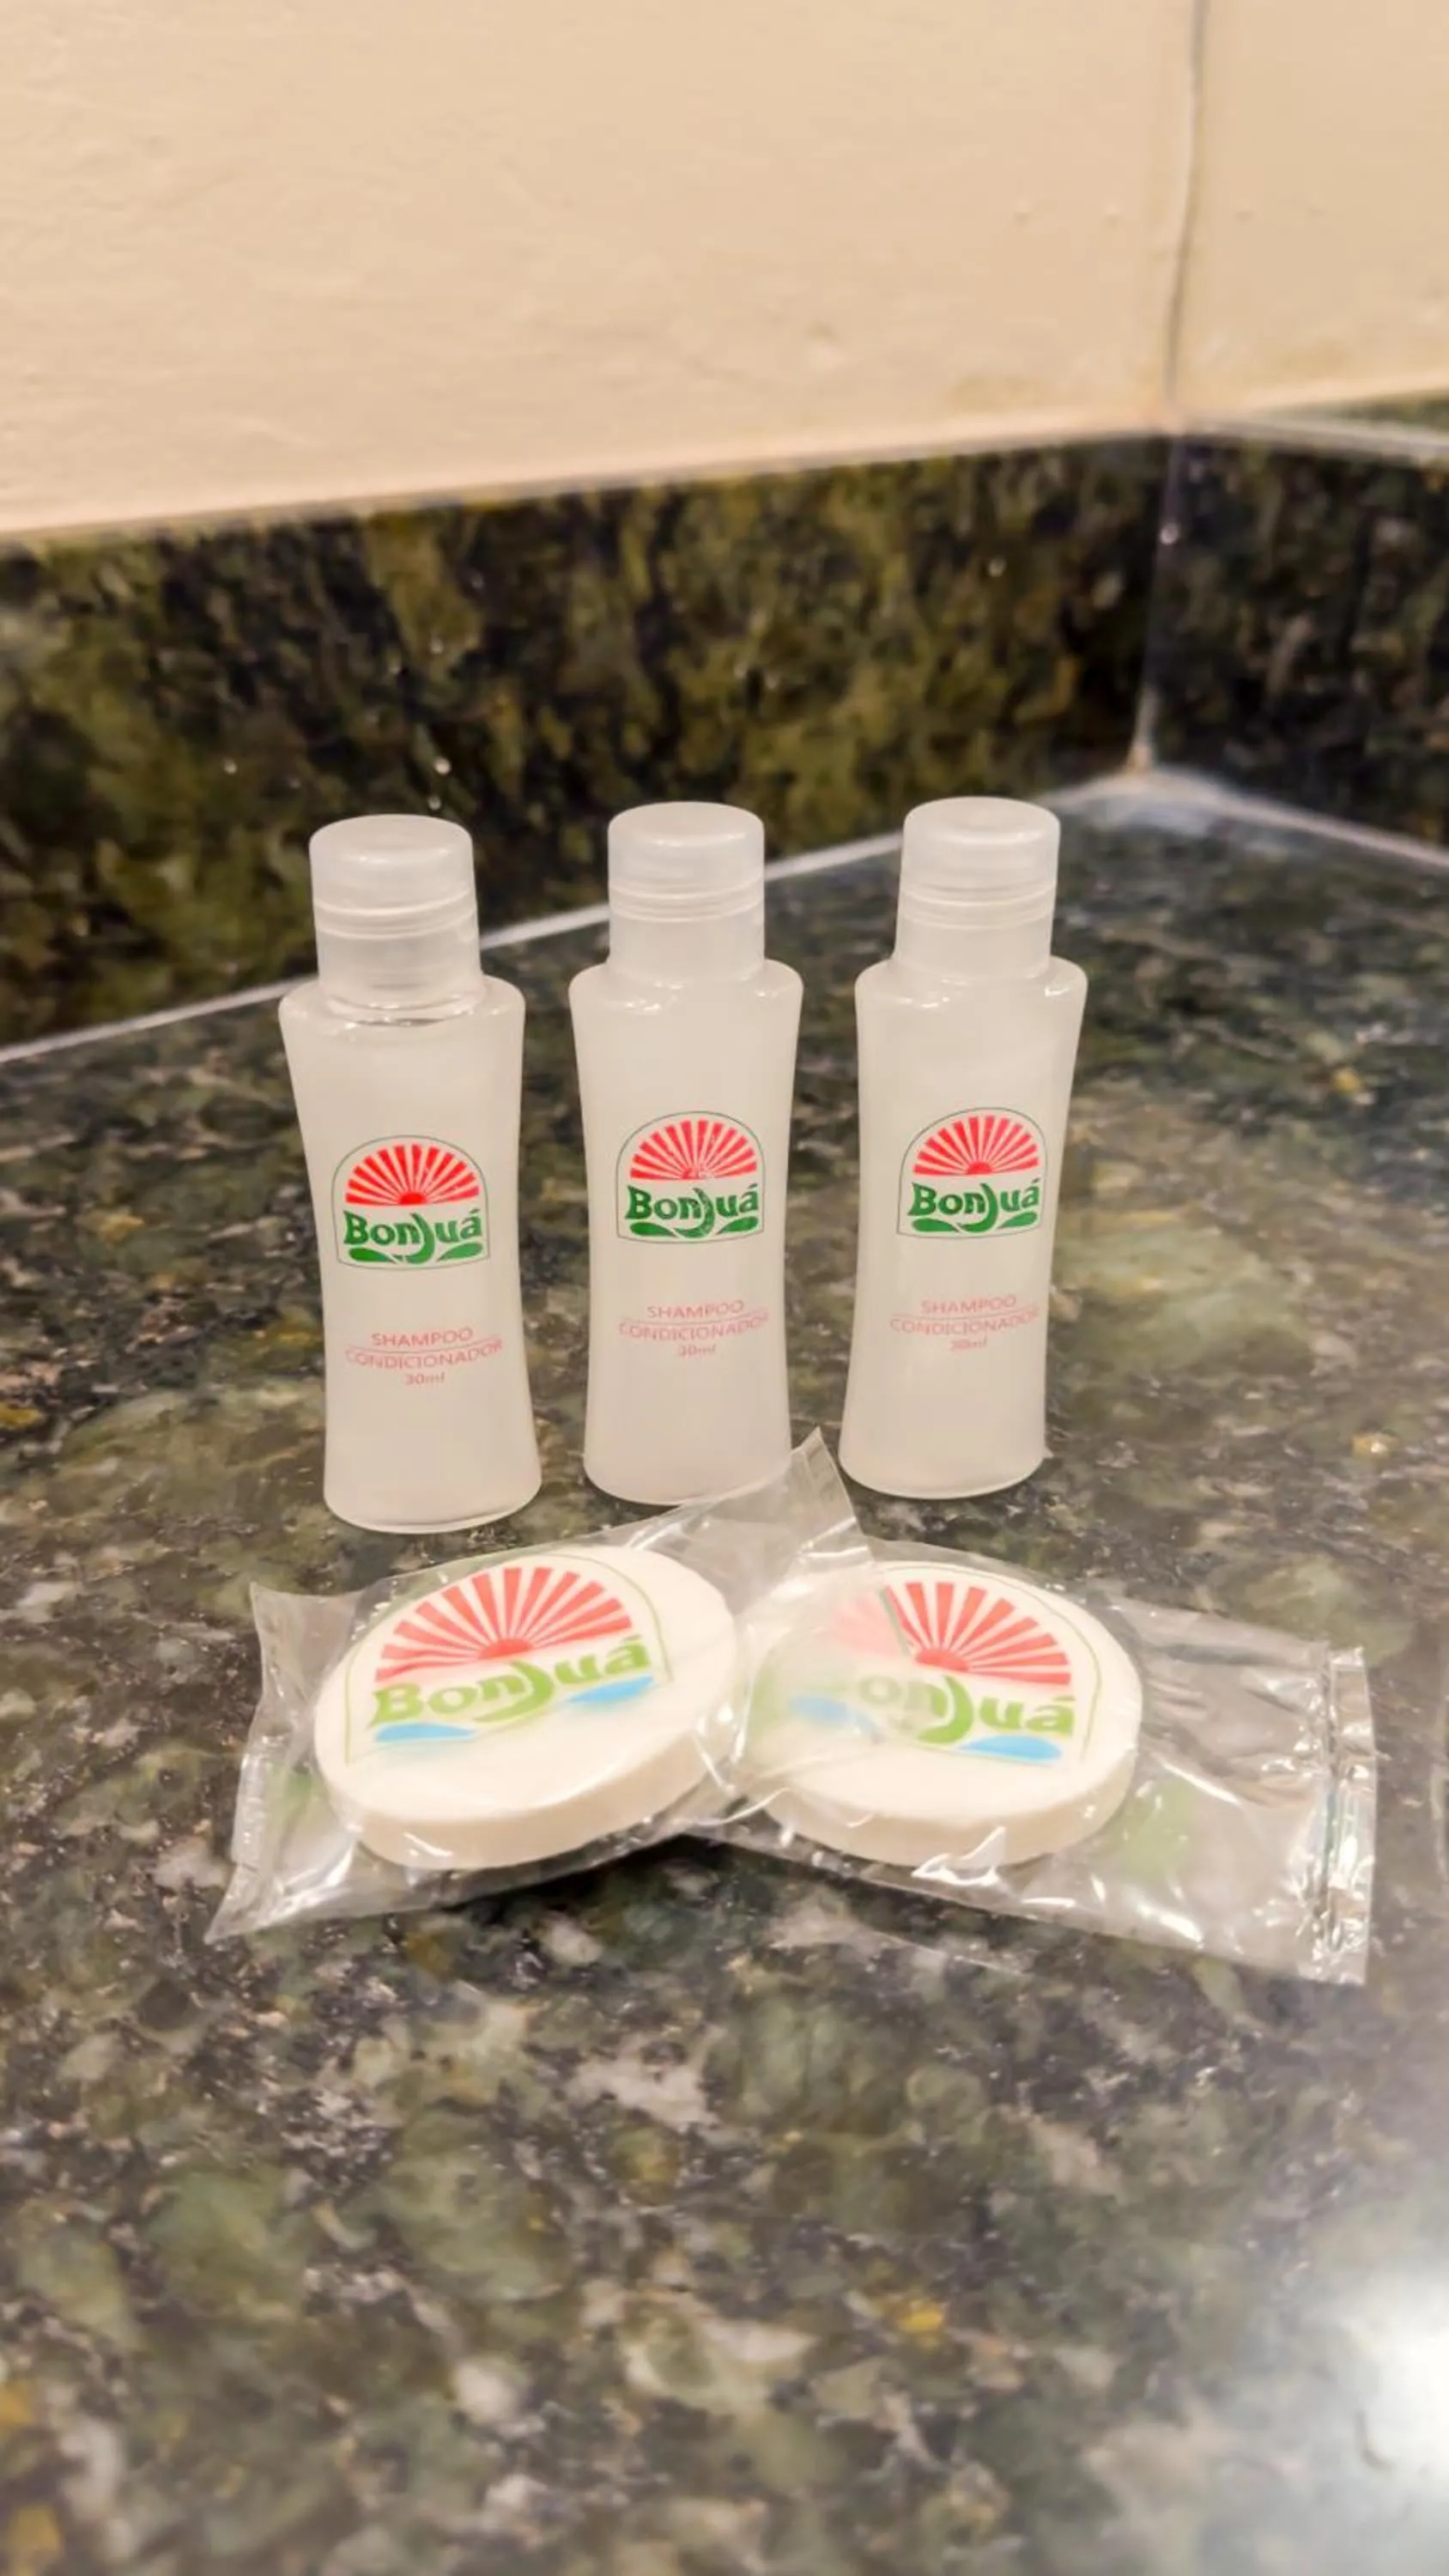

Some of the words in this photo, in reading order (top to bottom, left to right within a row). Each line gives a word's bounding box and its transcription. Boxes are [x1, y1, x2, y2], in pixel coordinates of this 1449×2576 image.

[646, 1299, 745, 1320] SHAMPOO
[920, 1294, 1017, 1315] SHAMPOO
[372, 1327, 474, 1348] SHAMPOO
[345, 1339, 504, 1370] CONDICIONADOR
[807, 1673, 1076, 1745] onJuá
